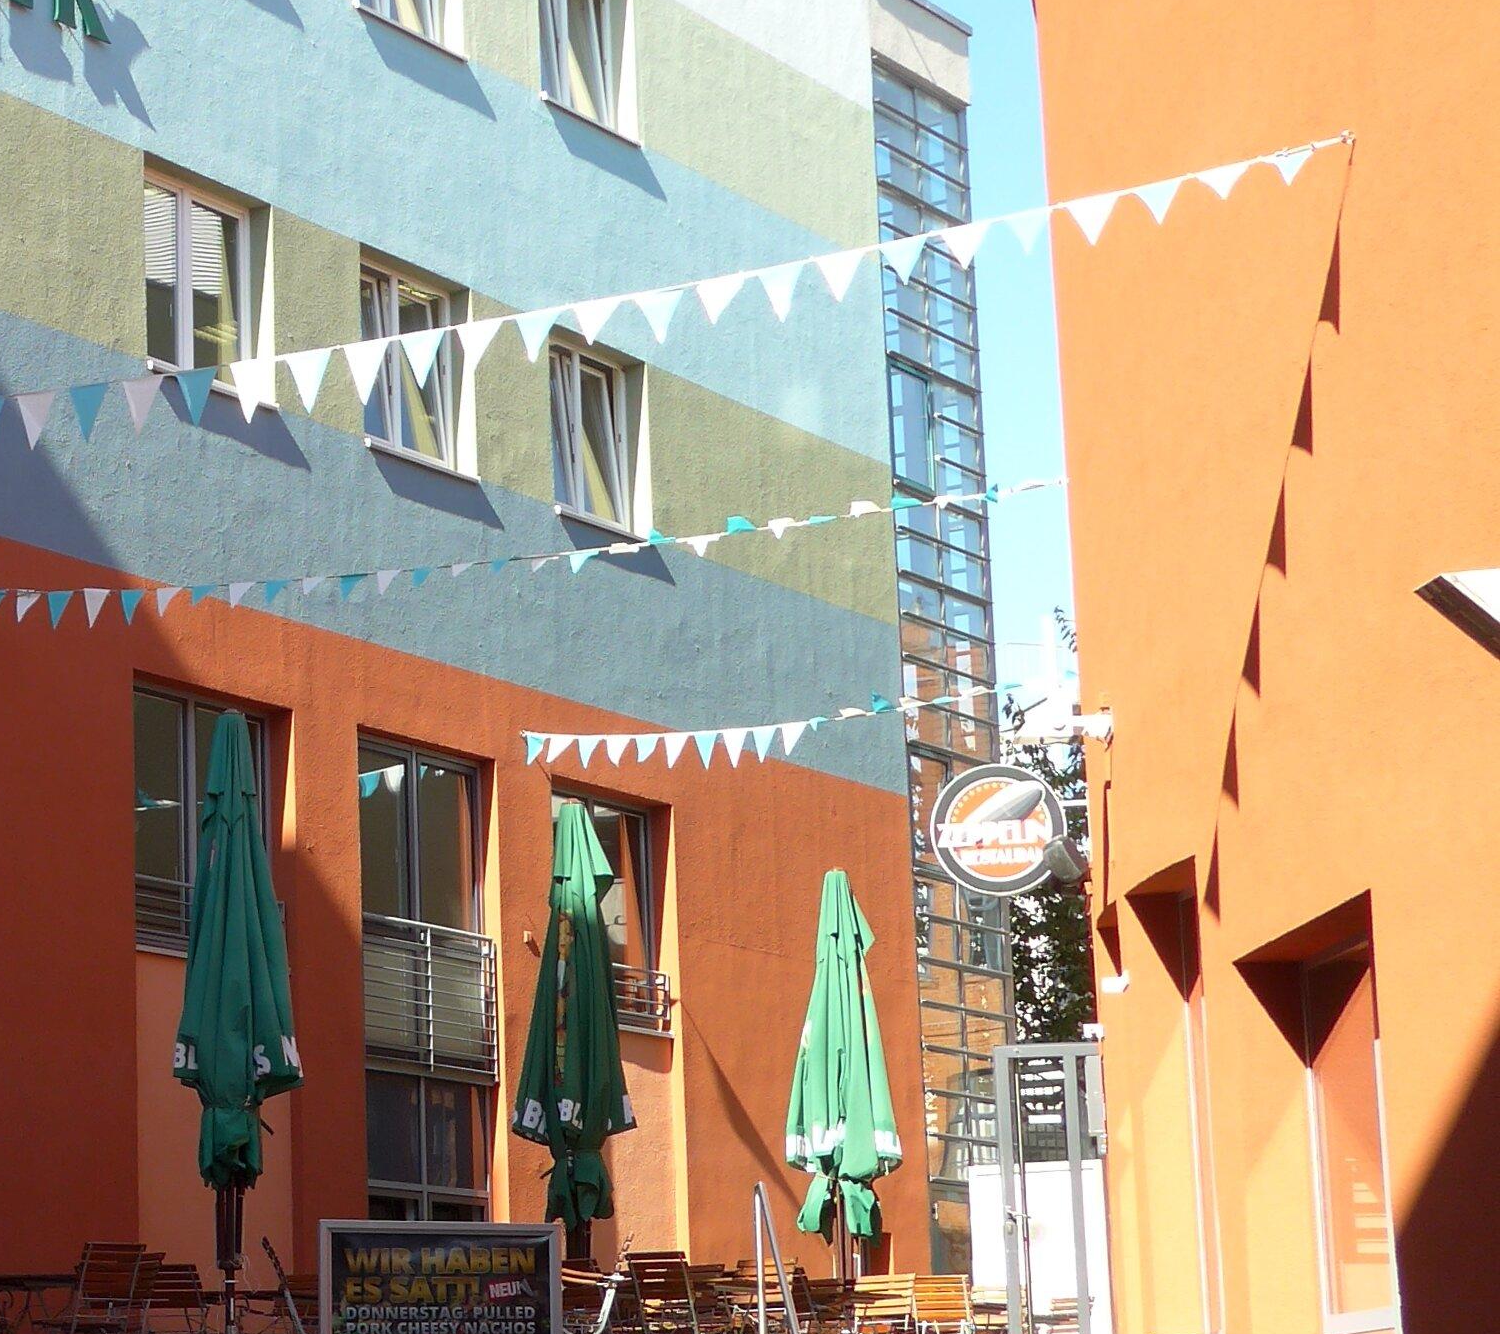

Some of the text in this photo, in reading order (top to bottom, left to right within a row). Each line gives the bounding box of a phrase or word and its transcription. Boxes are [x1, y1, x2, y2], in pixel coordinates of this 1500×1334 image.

[344, 1244, 536, 1275] WIR HABEN
[345, 1276, 383, 1304] ES
[346, 1306, 536, 1320] DONNERSTAG: PULLED
[346, 1322, 394, 1334] PORK
[465, 1322, 537, 1334] NACHOS
